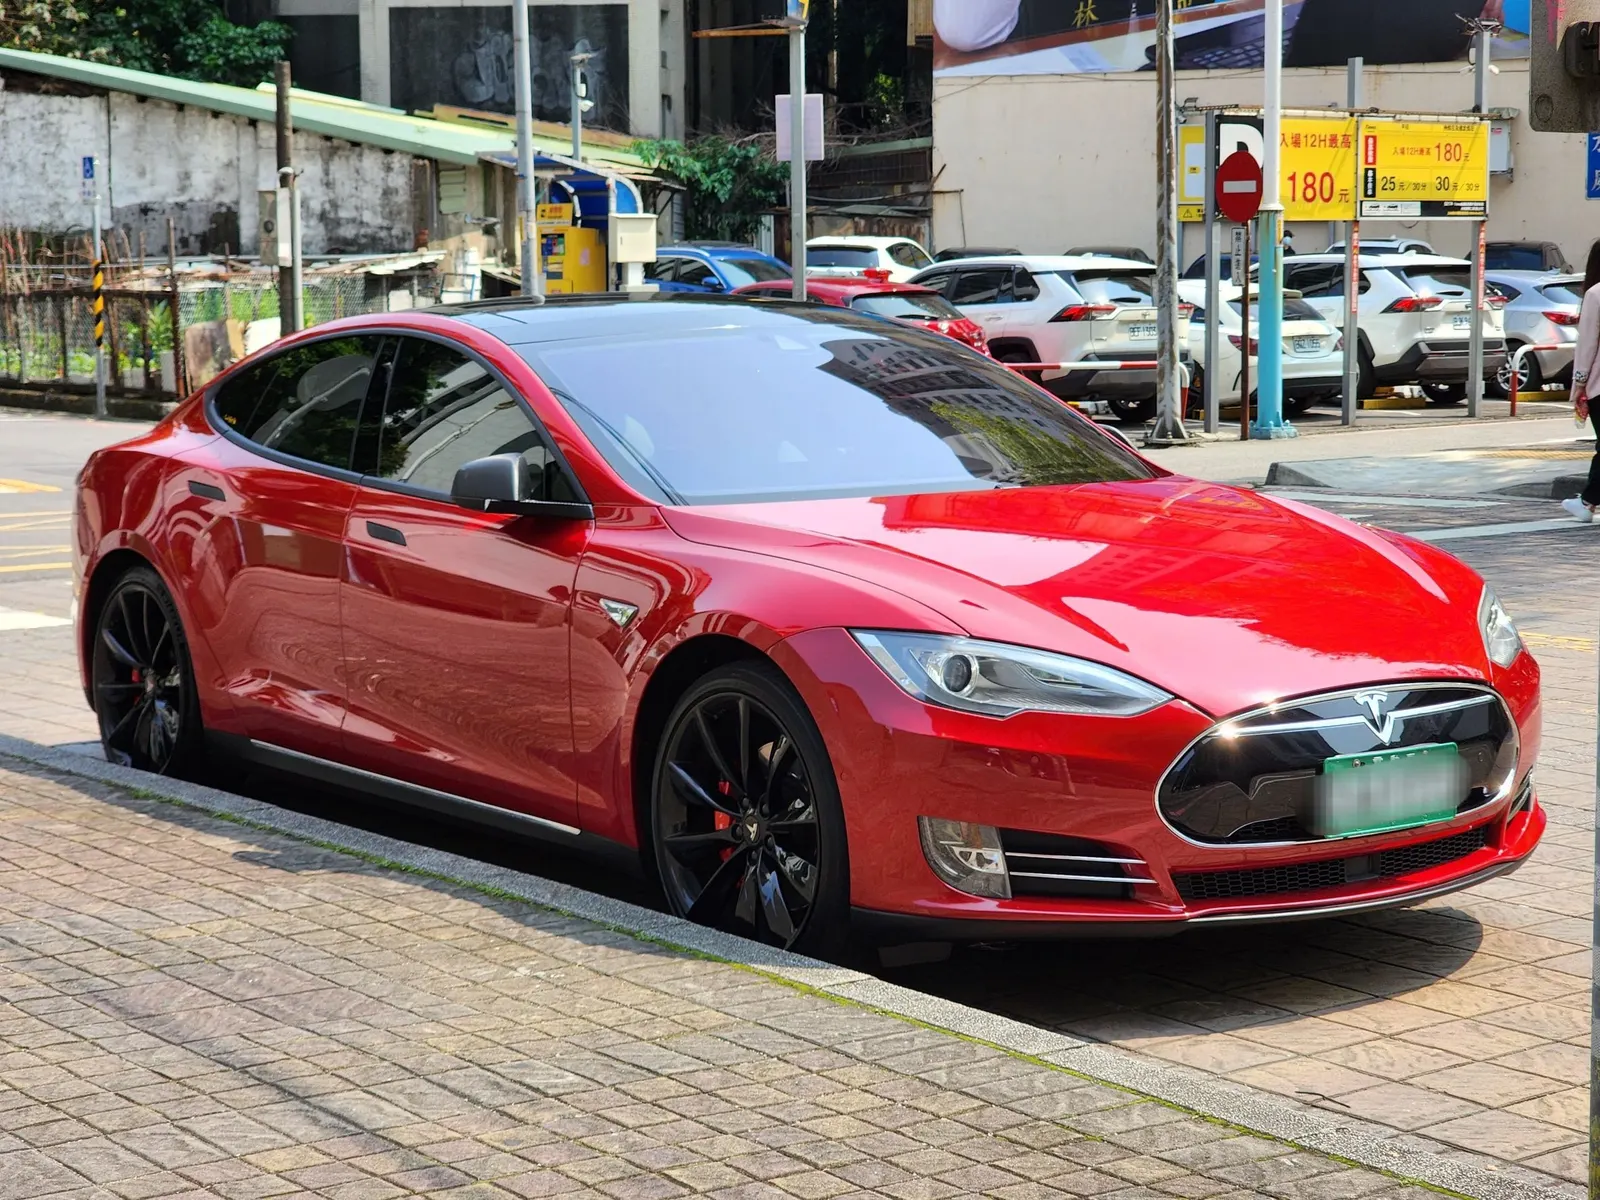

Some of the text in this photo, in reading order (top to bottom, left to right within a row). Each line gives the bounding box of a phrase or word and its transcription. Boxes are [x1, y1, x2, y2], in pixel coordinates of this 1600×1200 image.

[1280, 132, 1352, 149] 入場12H最高
[1434, 142, 1462, 162] 180
[1287, 171, 1350, 203] 180 元
[1381, 176, 1396, 191] 25
[1435, 176, 1450, 191] 30
